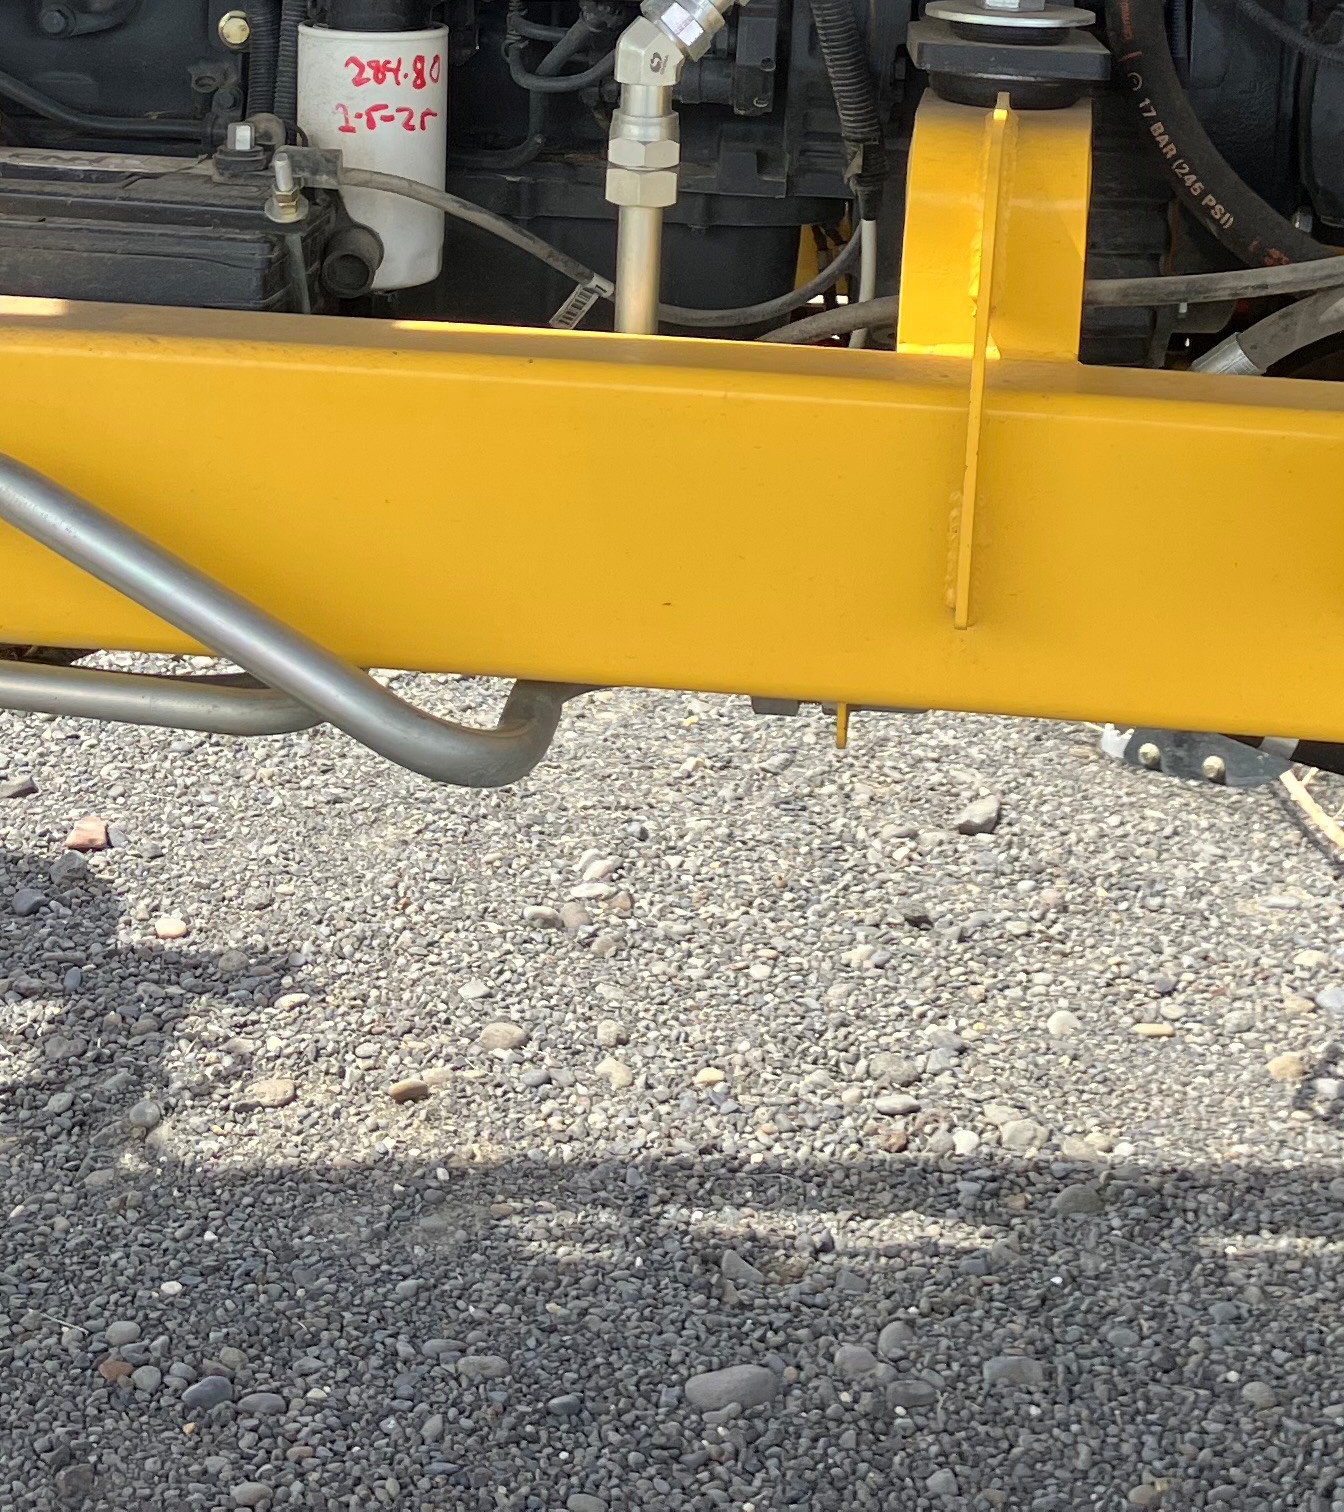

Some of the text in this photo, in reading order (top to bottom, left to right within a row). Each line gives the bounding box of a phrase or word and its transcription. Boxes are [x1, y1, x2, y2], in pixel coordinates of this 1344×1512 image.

[344, 55, 440, 89] 284.80
[1139, 98, 1235, 229] 17 BAR (245 PSI)
